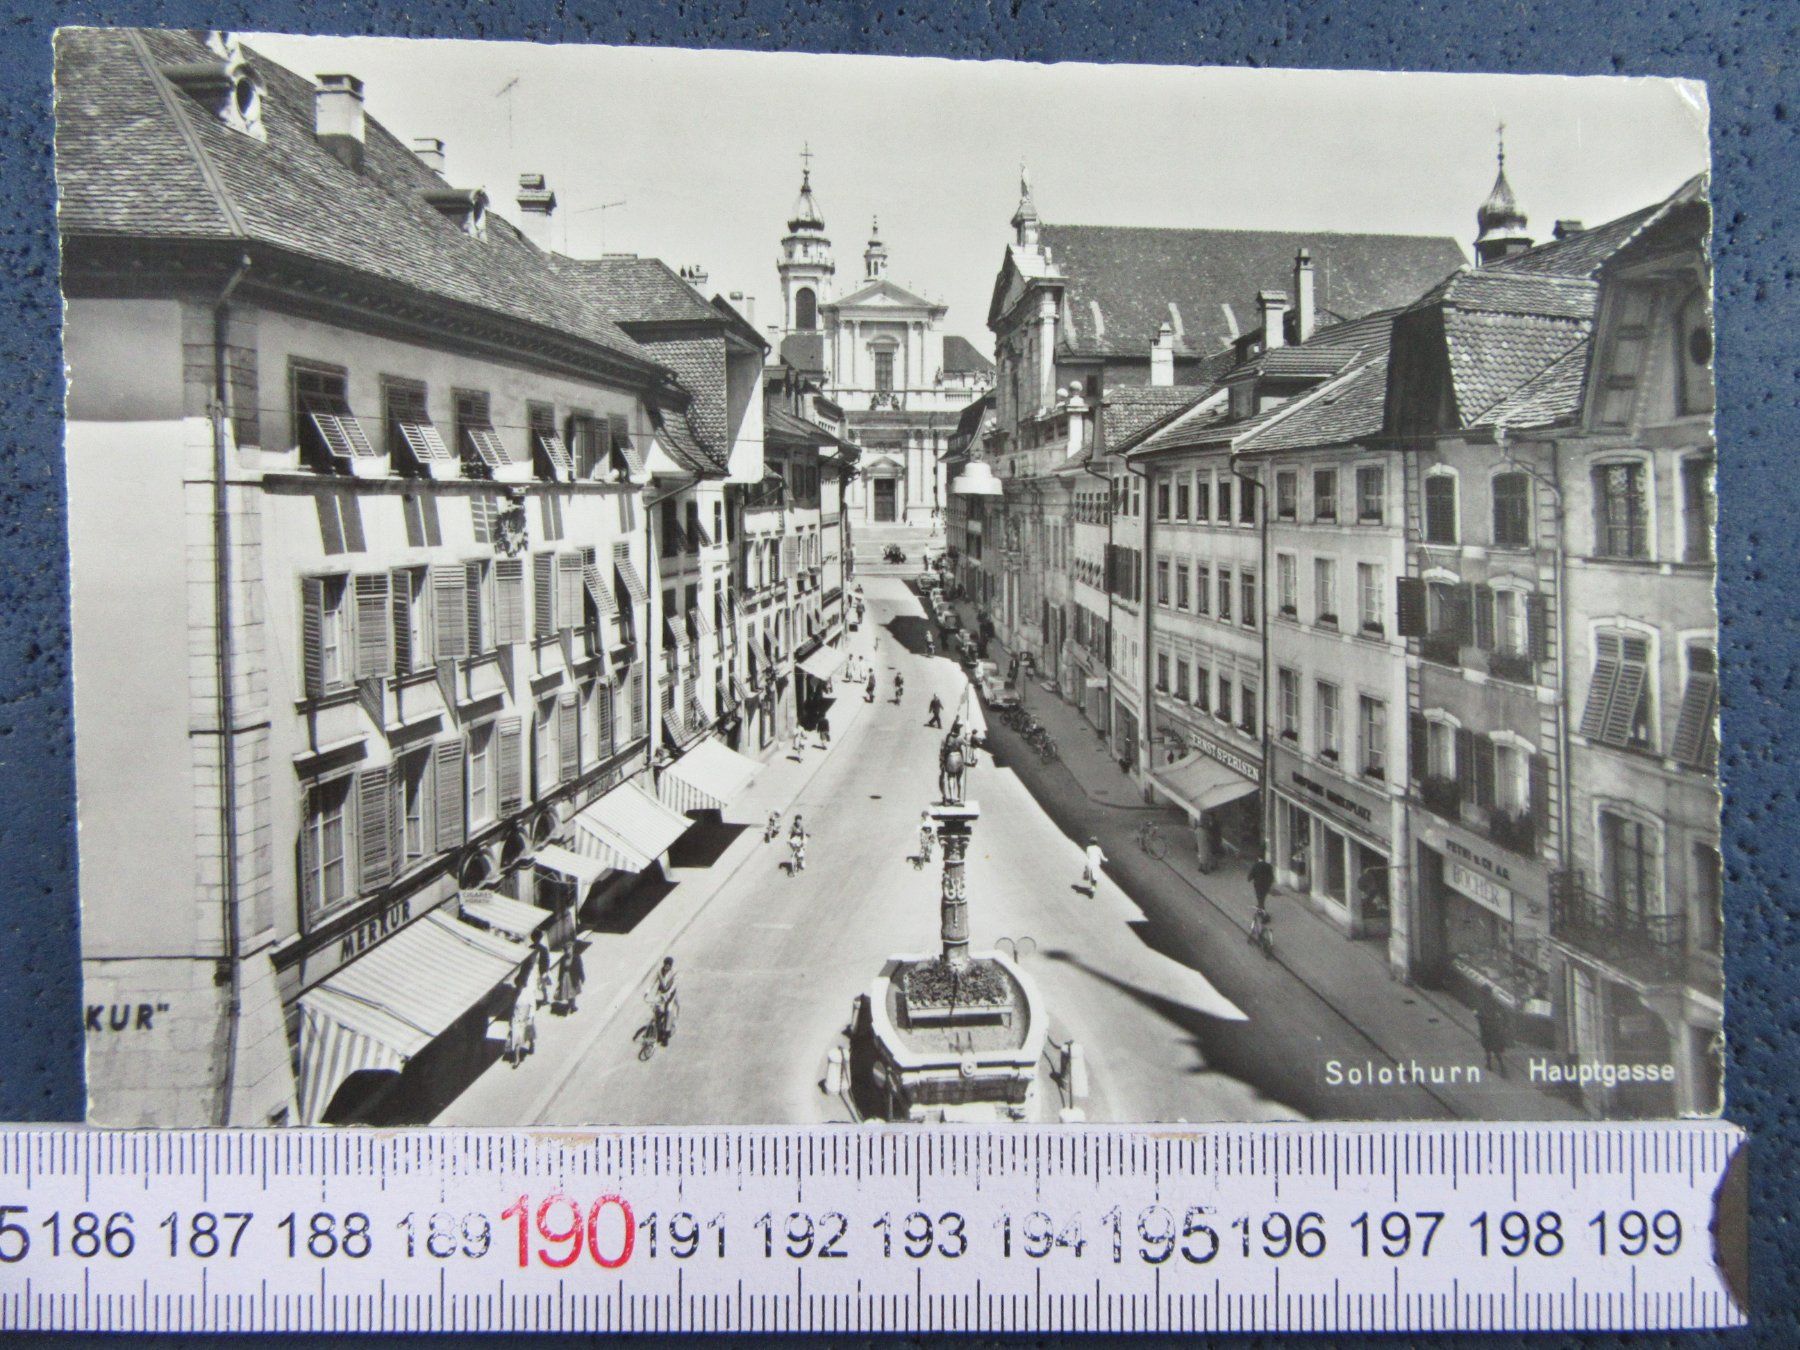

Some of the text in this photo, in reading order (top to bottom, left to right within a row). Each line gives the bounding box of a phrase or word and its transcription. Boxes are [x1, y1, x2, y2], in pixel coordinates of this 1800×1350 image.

[341, 900, 411, 962] MERKUR
[42, 1211, 136, 1257] 186
[160, 1211, 254, 1257] 187
[278, 1211, 373, 1257] 188
[397, 1211, 492, 1258] 189
[501, 1195, 636, 1268] 190
[639, 1211, 727, 1258] 191
[754, 1211, 849, 1258] 192
[873, 1211, 968, 1258] 193
[993, 1211, 1088, 1258] 194
[1102, 1206, 1220, 1264] 195
[1232, 1211, 1327, 1258] 196
[1351, 1211, 1446, 1257] 197
[1470, 1210, 1565, 1257] 198
[1589, 1209, 1684, 1257] 199
